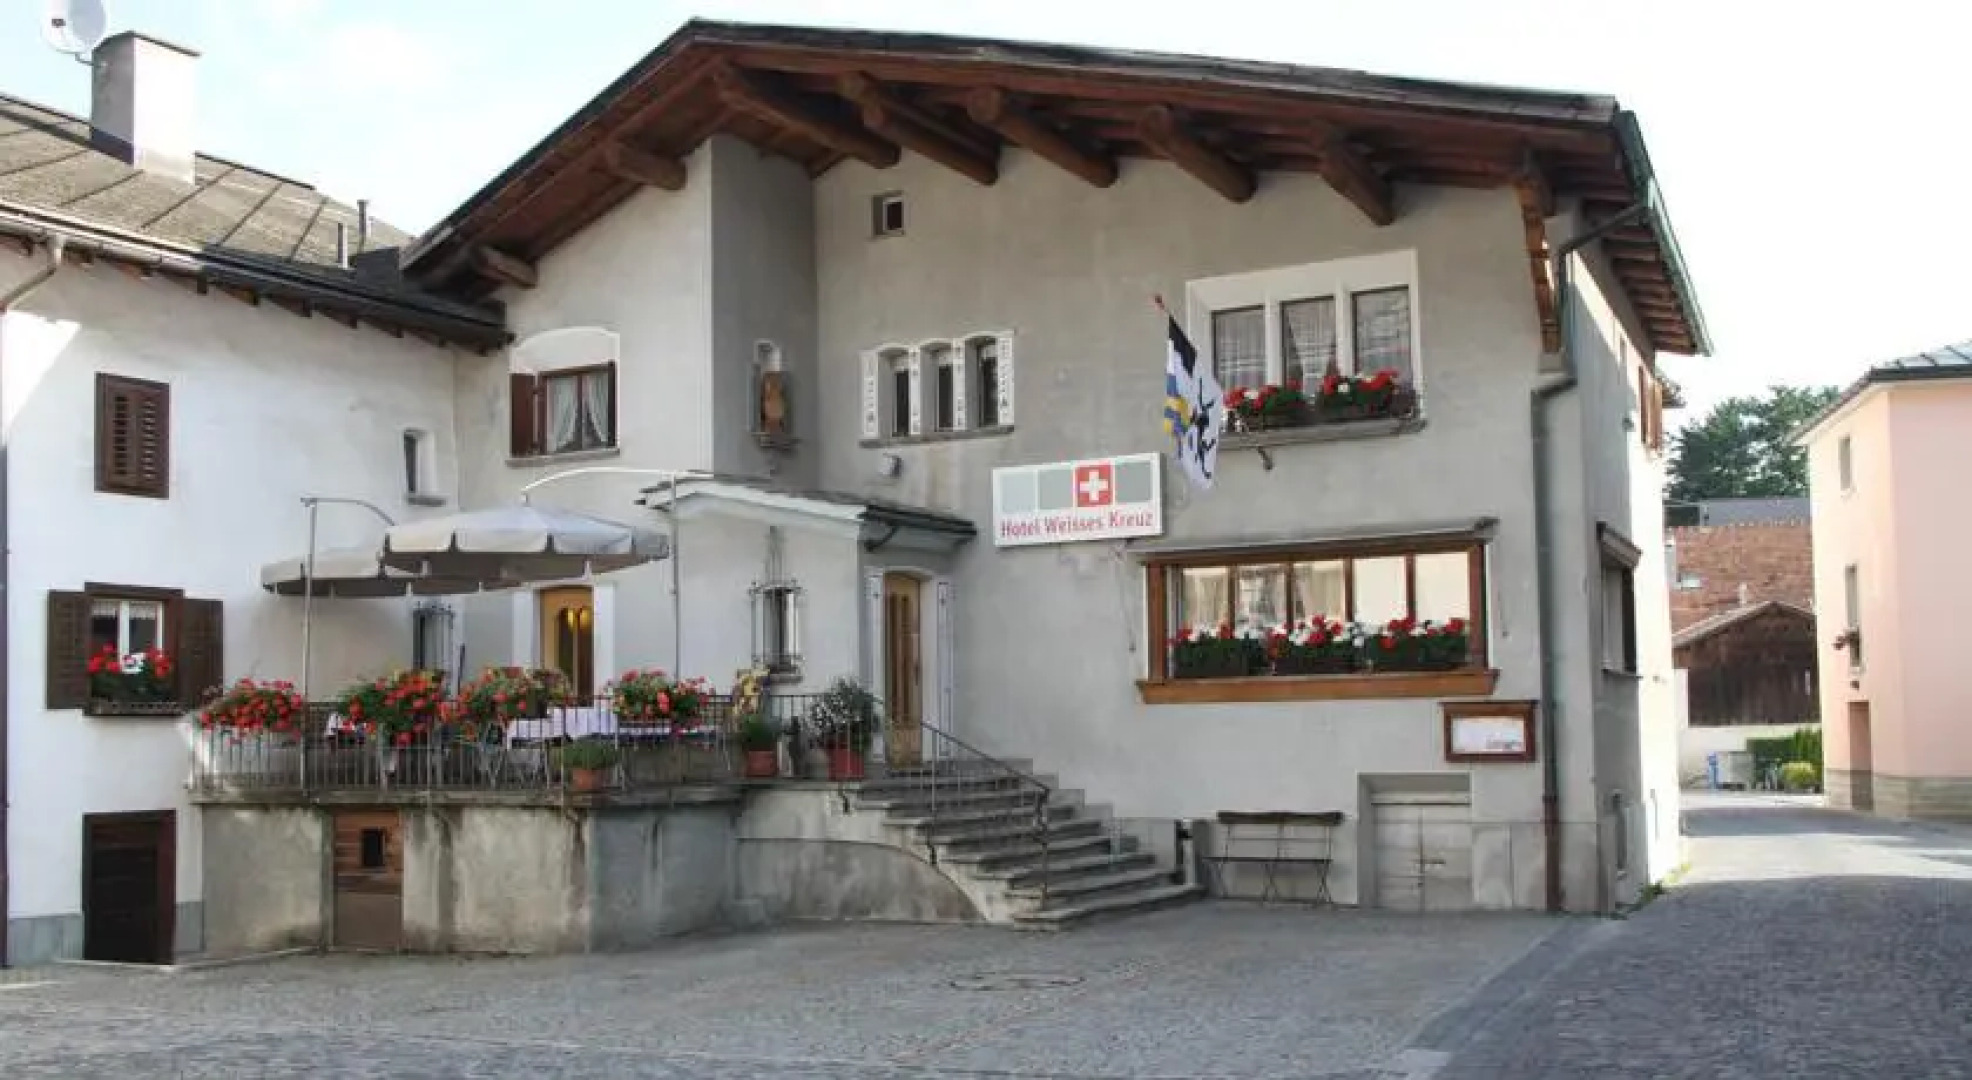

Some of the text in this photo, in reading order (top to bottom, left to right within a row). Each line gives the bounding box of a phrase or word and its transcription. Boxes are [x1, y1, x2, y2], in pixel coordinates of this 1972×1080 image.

[1001, 508, 1154, 537] Hotel Weisses Kreuz
